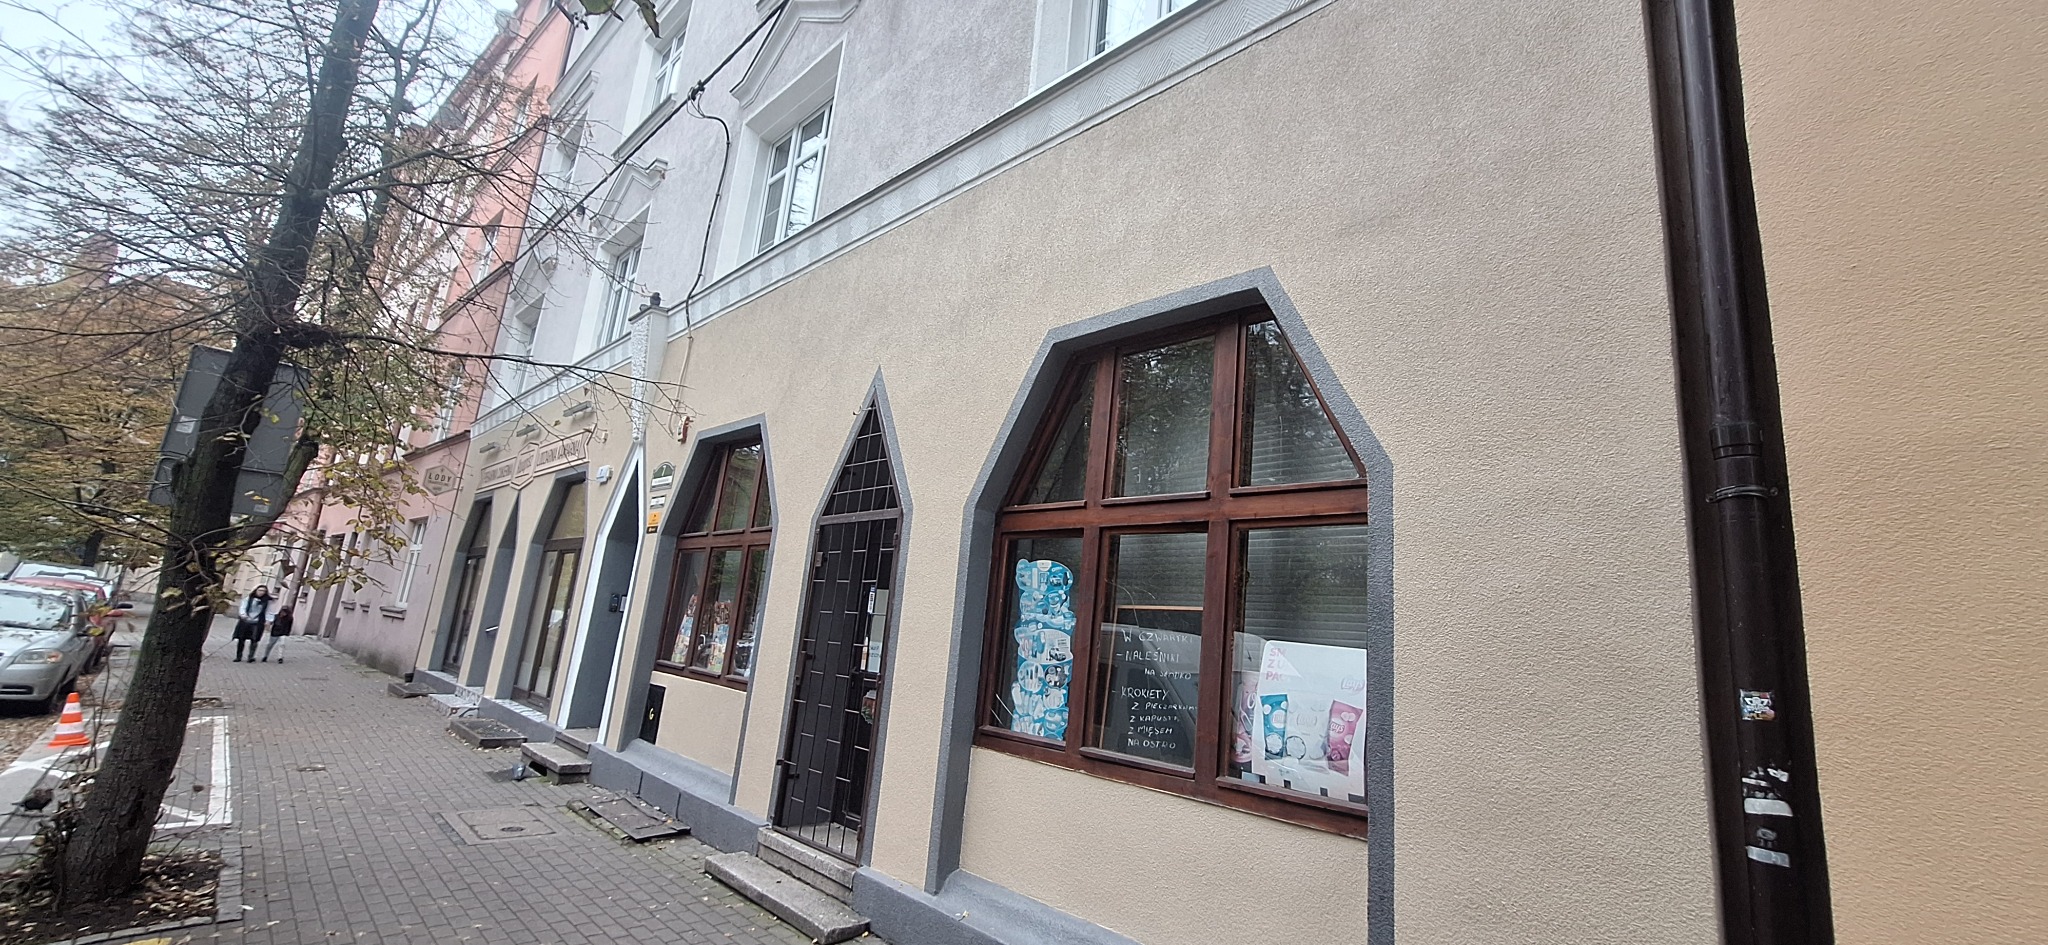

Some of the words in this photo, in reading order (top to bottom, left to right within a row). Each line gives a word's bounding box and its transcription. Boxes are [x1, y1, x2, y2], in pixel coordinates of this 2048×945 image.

[428, 473, 452, 483] LODY
[1121, 628, 1132, 643] W
[1138, 631, 1193, 644] CZWARTKI
[1144, 668, 1156, 676] NA
[1120, 686, 1169, 701] KROKIETY
[1137, 724, 1173, 738] MIĘSEM
[1127, 738, 1140, 747] NA
[1142, 739, 1176, 749] OSTRO
